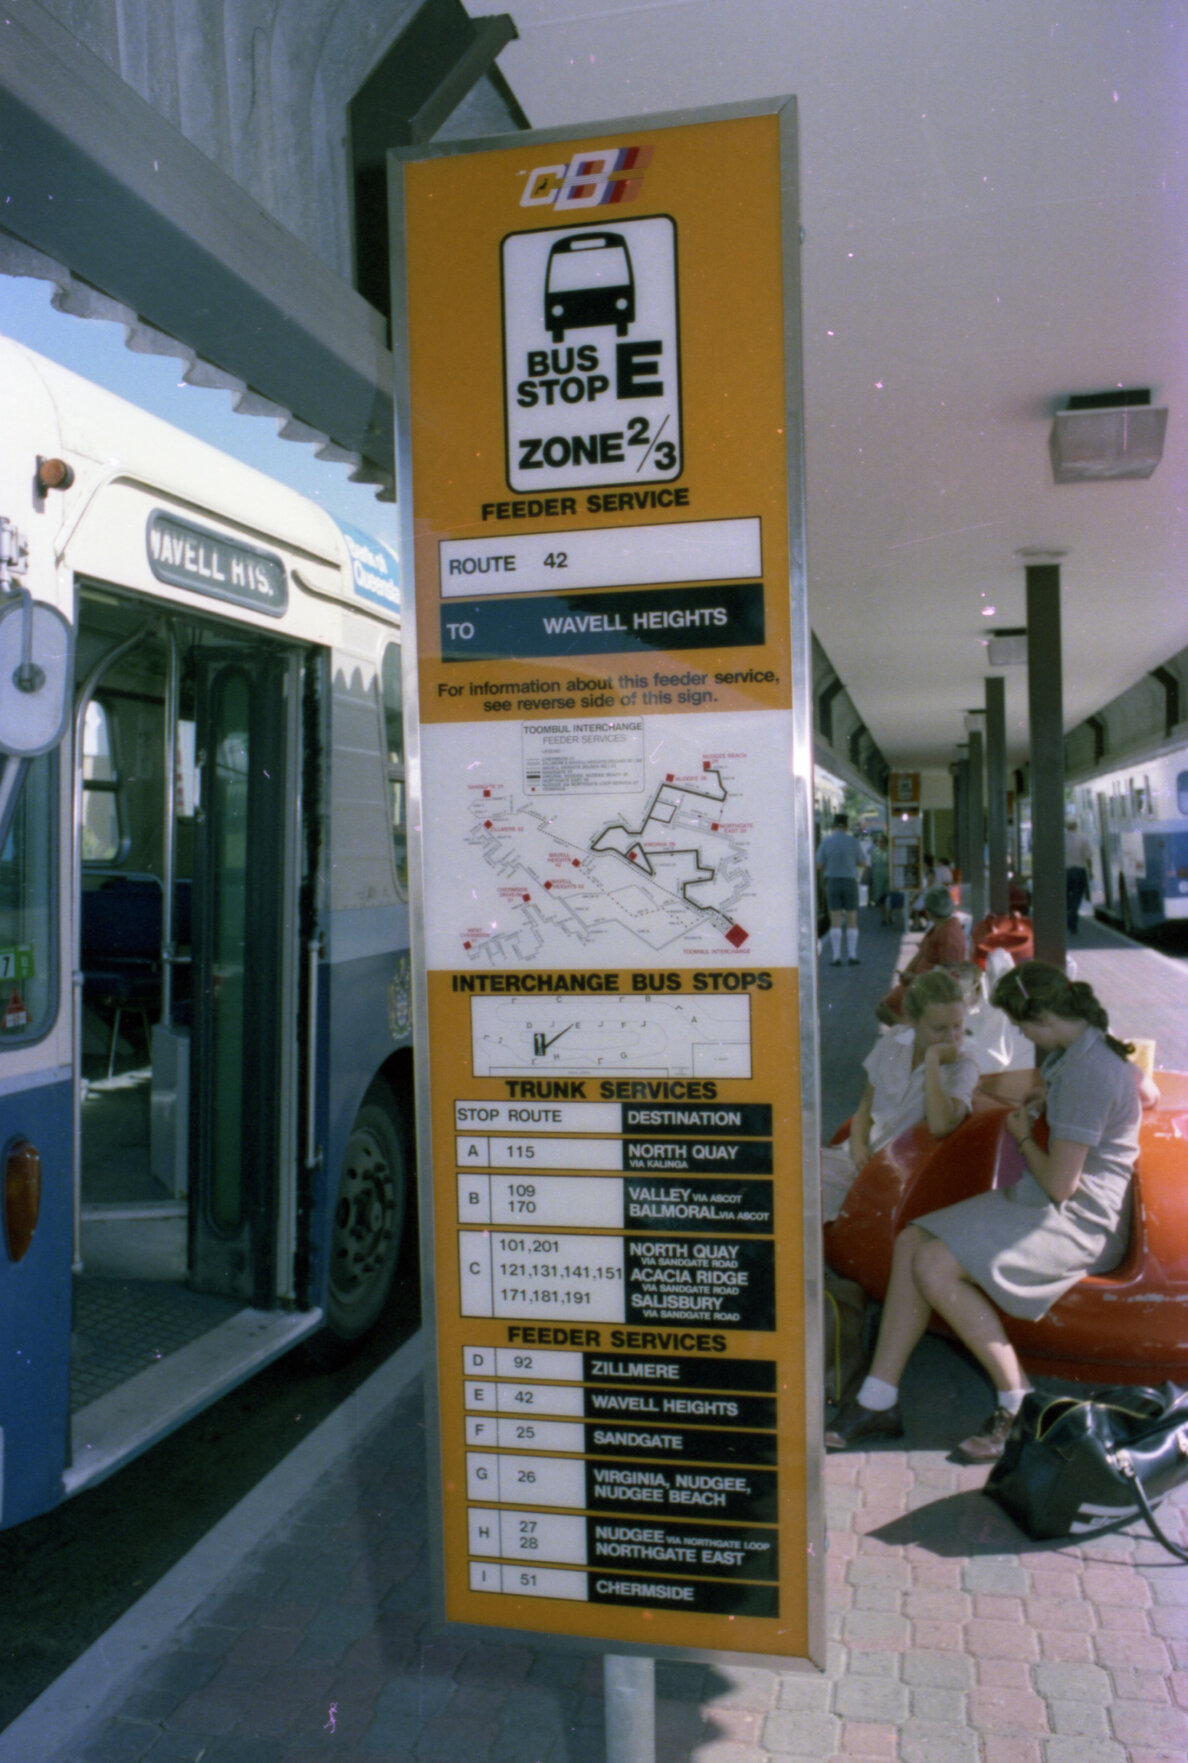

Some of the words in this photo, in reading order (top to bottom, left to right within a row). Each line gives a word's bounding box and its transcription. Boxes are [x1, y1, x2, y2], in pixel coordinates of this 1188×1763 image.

[527, 344, 599, 378] BUS
[616, 340, 664, 401] E
[516, 375, 610, 408] STOP
[518, 431, 625, 470] ZONE
[481, 496, 577, 521] FEEDER
[586, 488, 690, 514] SERVICE
[449, 556, 516, 575] ROUTE
[543, 552, 568, 569] 42
[446, 622, 475, 640] TO
[543, 614, 627, 635] WAVELL
[633, 608, 728, 629] HEIGHTS
[438, 683, 464, 697] For
[469, 678, 561, 696] information
[566, 675, 613, 692] about
[618, 673, 649, 689] this
[654, 671, 708, 687] feeder
[714, 669, 780, 686] service,
[483, 700, 512, 712] see
[517, 697, 576, 711] reverse
[581, 692, 615, 708] side
[620, 691, 637, 706] of
[642, 689, 672, 705] this
[677, 690, 718, 708] sign.
[524, 725, 570, 734] TOOMBUL
[573, 722, 643, 733] INTERCHANGE
[543, 735, 579, 745] FEEDER
[581, 734, 627, 744] SERVICES
[452, 974, 619, 992] INTERCHANGE
[631, 973, 681, 992] BUS
[692, 972, 773, 991] STOPS
[505, 1081, 586, 1099] TRUNK
[600, 1081, 717, 1100] SERVICES
[457, 1108, 499, 1122] STOP
[508, 1109, 562, 1123] ROUTE
[627, 1111, 742, 1126] DESTINATION
[467, 1145, 479, 1158] A
[507, 1145, 535, 1159] 115
[628, 1144, 687, 1159] NORTH
[692, 1145, 739, 1160] QUAY
[629, 1160, 644, 1168] VIA
[646, 1160, 688, 1169] KALINGA
[469, 1192, 479, 1204] B
[508, 1184, 536, 1198] 109
[628, 1187, 691, 1202] VALLEY
[692, 1194, 707, 1202] VIA
[710, 1194, 742, 1204] ASCOT
[508, 1200, 536, 1214] 170
[629, 1204, 719, 1219] BALMORAL
[720, 1212, 735, 1220] VIA
[737, 1212, 769, 1222] ASCOT
[500, 1239, 560, 1255] 101,201
[629, 1242, 688, 1258] NORTH
[694, 1244, 739, 1259] QUAY
[469, 1262, 480, 1275] C
[641, 1257, 656, 1266] VIA
[658, 1258, 709, 1268] SANDGATE
[712, 1259, 738, 1269] ROAD
[630, 1268, 691, 1283] ACACIA
[697, 1270, 748, 1286] RIDGE
[501, 1288, 592, 1305] 171,181,191
[642, 1283, 657, 1292] VIA
[659, 1284, 709, 1295] SANDGATE
[713, 1286, 739, 1296] ROAD
[631, 1294, 723, 1311] SALISBURY
[642, 1309, 658, 1318] VIA
[660, 1310, 710, 1321] SANDGATE
[714, 1312, 740, 1322] ROAD
[507, 1326, 601, 1347] FEEDER
[610, 1331, 727, 1352] SERVICES
[473, 1354, 484, 1367] D
[513, 1356, 533, 1369] 92
[591, 1361, 680, 1379] ZILLMERE
[474, 1388, 484, 1401] E
[514, 1391, 534, 1404] 42
[591, 1395, 658, 1412] WAVELL
[663, 1399, 738, 1416] HEIGHTS
[475, 1424, 484, 1436] F
[516, 1426, 535, 1439] 25
[593, 1431, 683, 1449] SANDGATE
[476, 1467, 488, 1480] G
[517, 1470, 536, 1483] 26
[594, 1469, 670, 1489] VIRGINIA,
[675, 1475, 752, 1494] NUDGEE,
[594, 1485, 664, 1502] NUDGEE
[669, 1490, 726, 1507] BEACH
[479, 1526, 489, 1538] H
[519, 1520, 538, 1533] 27
[519, 1537, 538, 1549] 28
[596, 1526, 664, 1543] NUDGEE
[666, 1536, 682, 1544] VIA
[683, 1537, 741, 1549] NORTHGATE
[744, 1540, 770, 1551] LOOP
[596, 1543, 697, 1563] NORTHGATE
[701, 1550, 745, 1566] EAST
[520, 1573, 537, 1586] 51
[596, 1580, 695, 1601] CHERMSIDE
